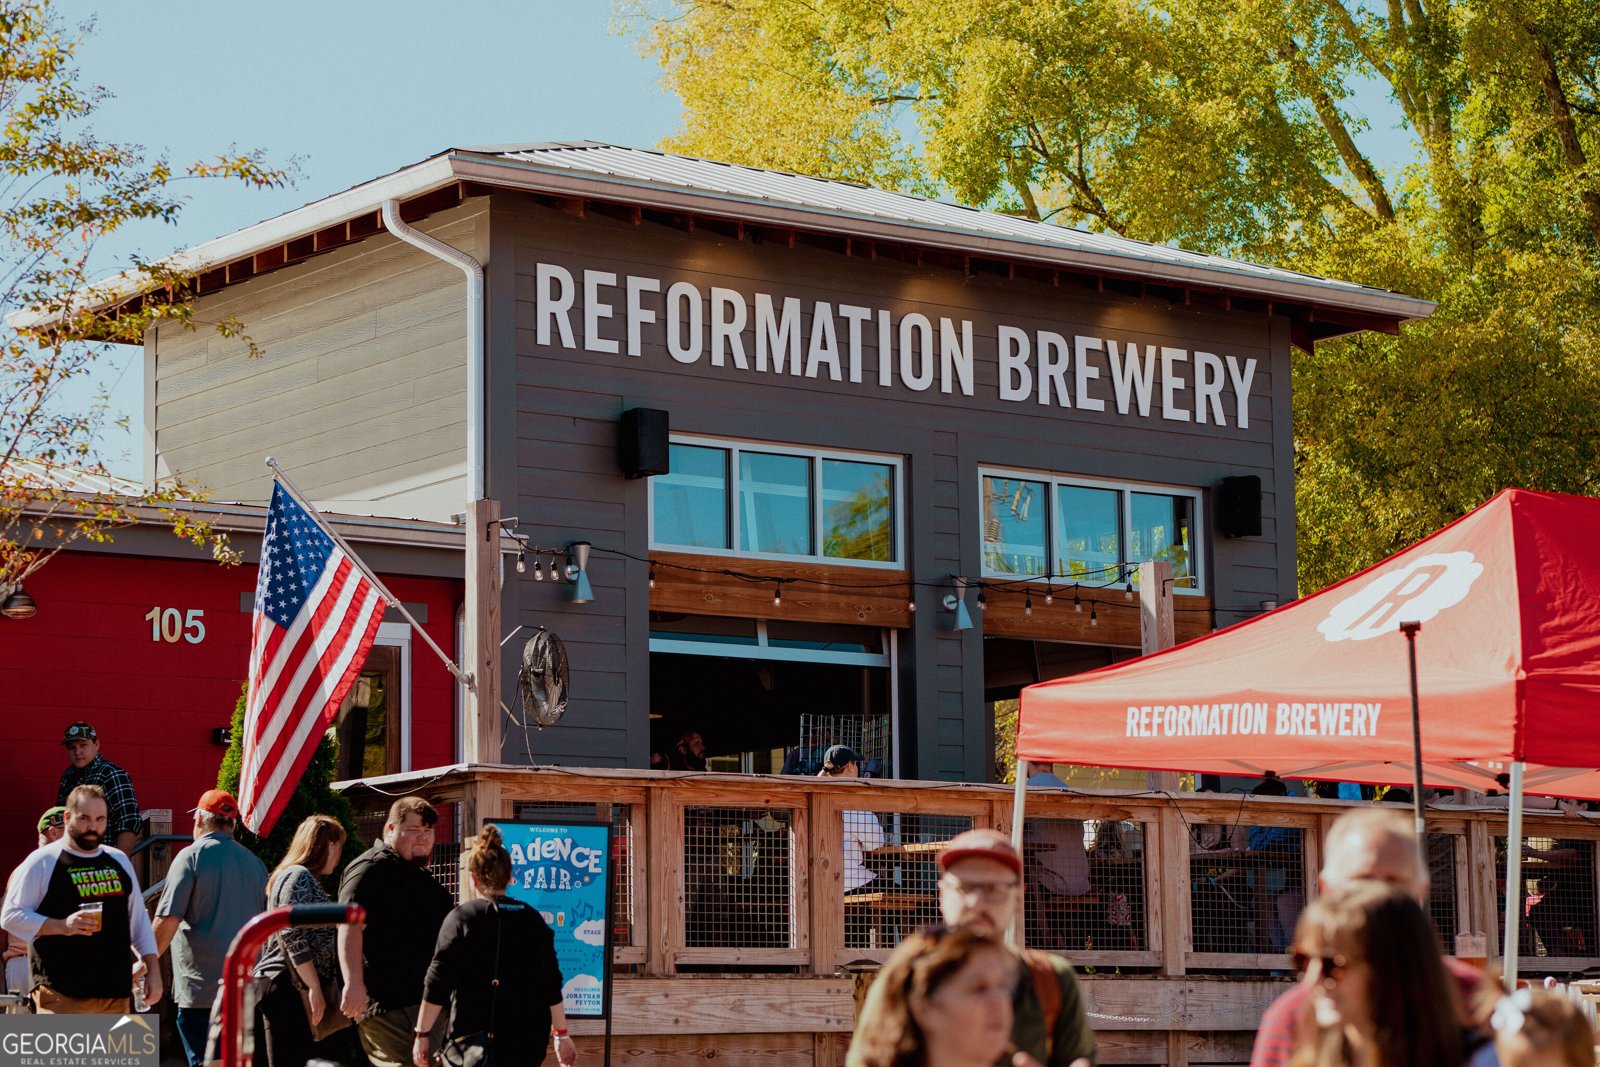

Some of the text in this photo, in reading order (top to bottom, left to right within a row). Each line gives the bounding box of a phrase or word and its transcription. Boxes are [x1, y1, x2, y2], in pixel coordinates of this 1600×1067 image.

[535, 262, 1258, 430] REFORMATION BREWERY
[145, 606, 206, 644] 105
[1125, 703, 1382, 737] REFORMATION BREWERY
[70, 868, 120, 884] NETHER
[77, 880, 123, 897] WORLD
[523, 867, 572, 890] FAIR
